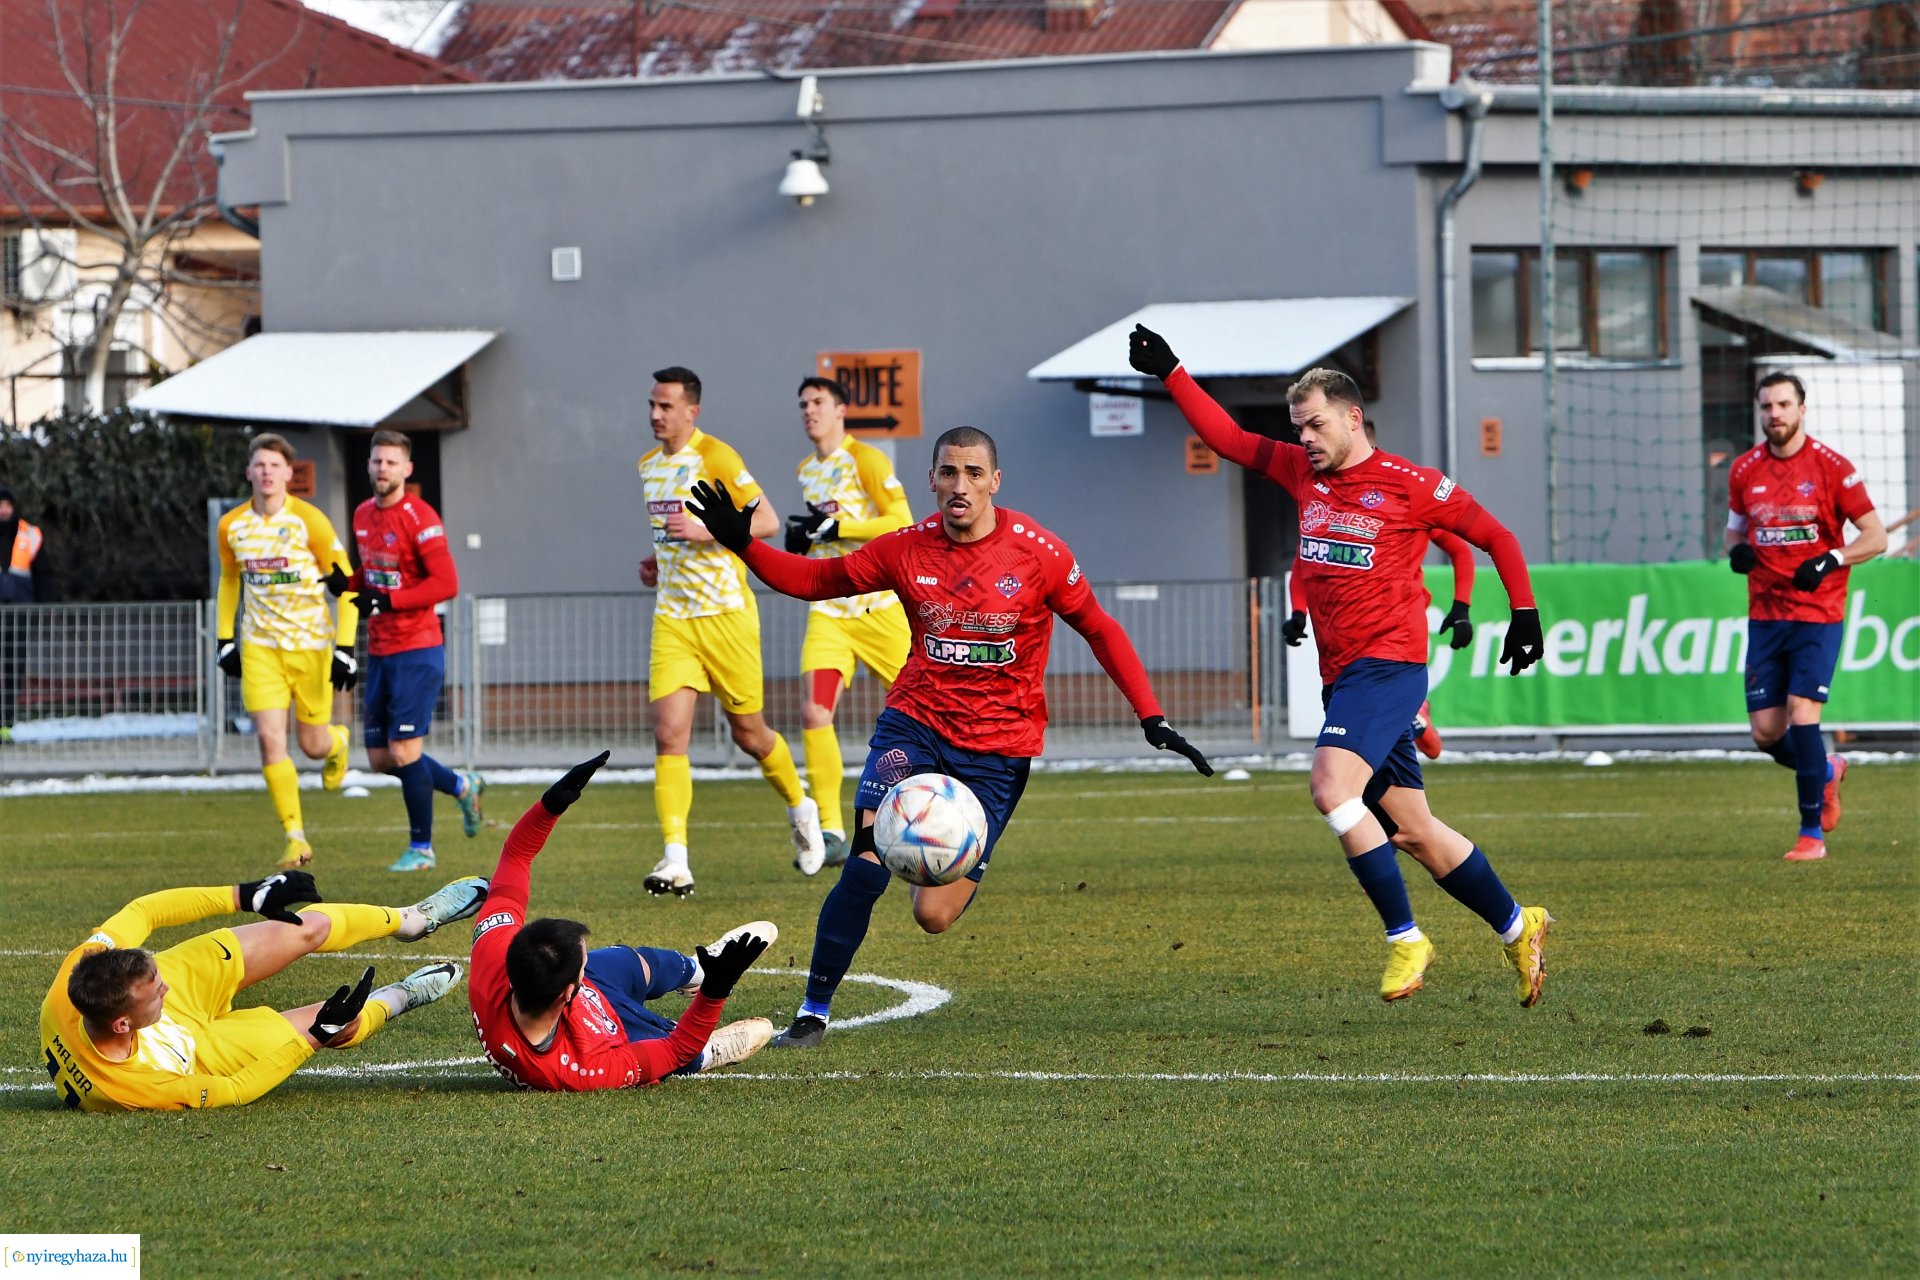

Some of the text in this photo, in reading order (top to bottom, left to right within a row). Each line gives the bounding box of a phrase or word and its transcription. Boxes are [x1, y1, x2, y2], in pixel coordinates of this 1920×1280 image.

[836, 358, 903, 407] BÜFÉ
[916, 575, 938, 585] JAKO
[953, 611, 1021, 627] REVESZ
[1323, 726, 1347, 736] JAKO
[53, 1034, 93, 1097] MAJOR
